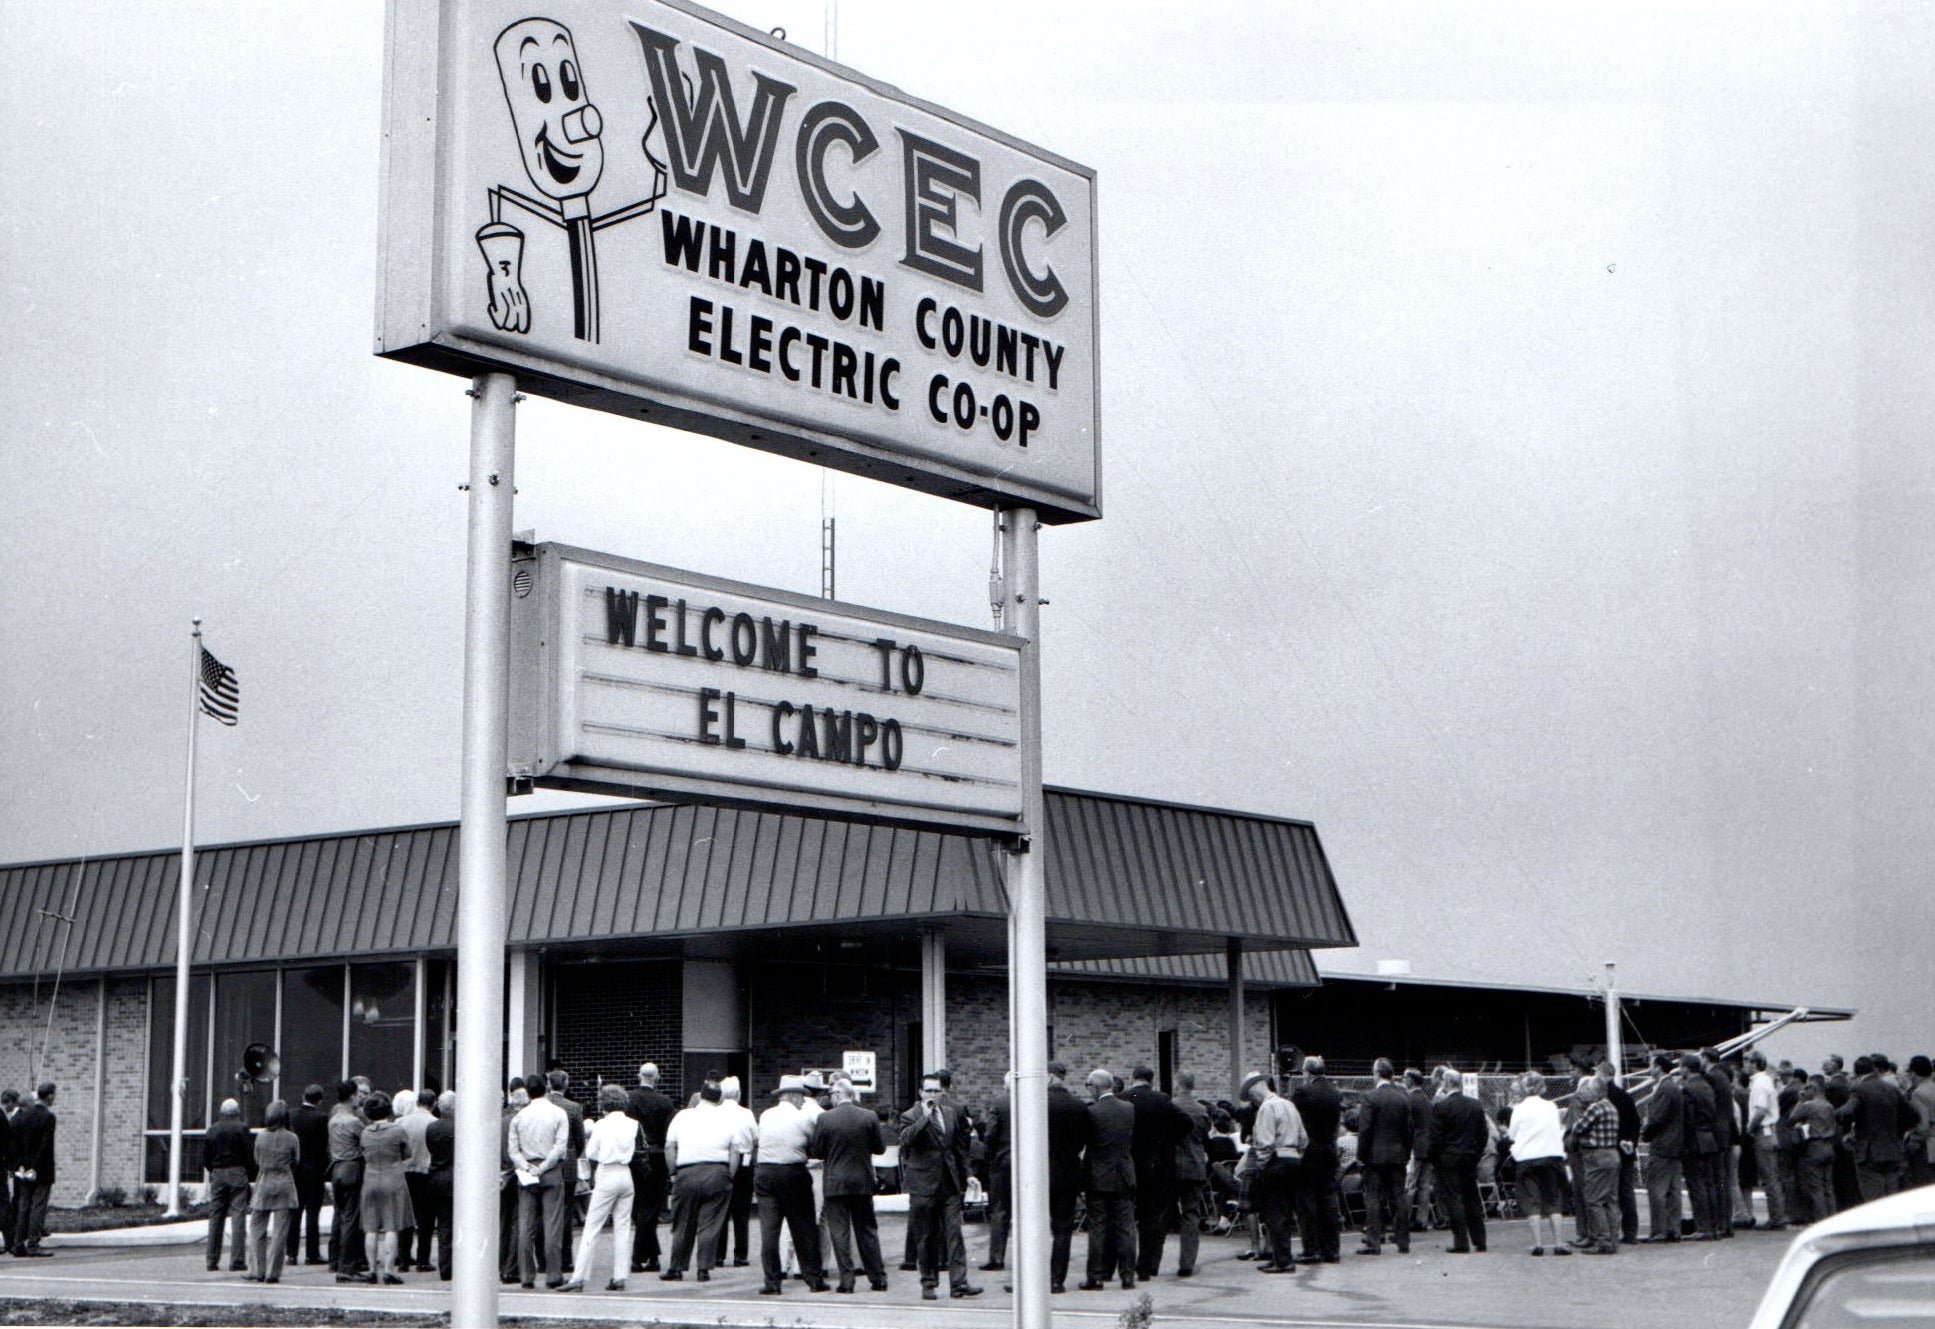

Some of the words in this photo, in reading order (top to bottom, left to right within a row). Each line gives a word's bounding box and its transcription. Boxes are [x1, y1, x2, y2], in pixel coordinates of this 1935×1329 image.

[626, 20, 1070, 319] WCEC
[660, 208, 885, 332] WHARTON
[915, 297, 1065, 391] COUNTY
[688, 295, 900, 411] ELECTRIC
[928, 373, 1041, 448] CO-OP
[606, 586, 818, 678] WELCOME
[876, 637, 925, 696] TO
[700, 686, 746, 749] EL
[772, 700, 902, 771] CAMPO
